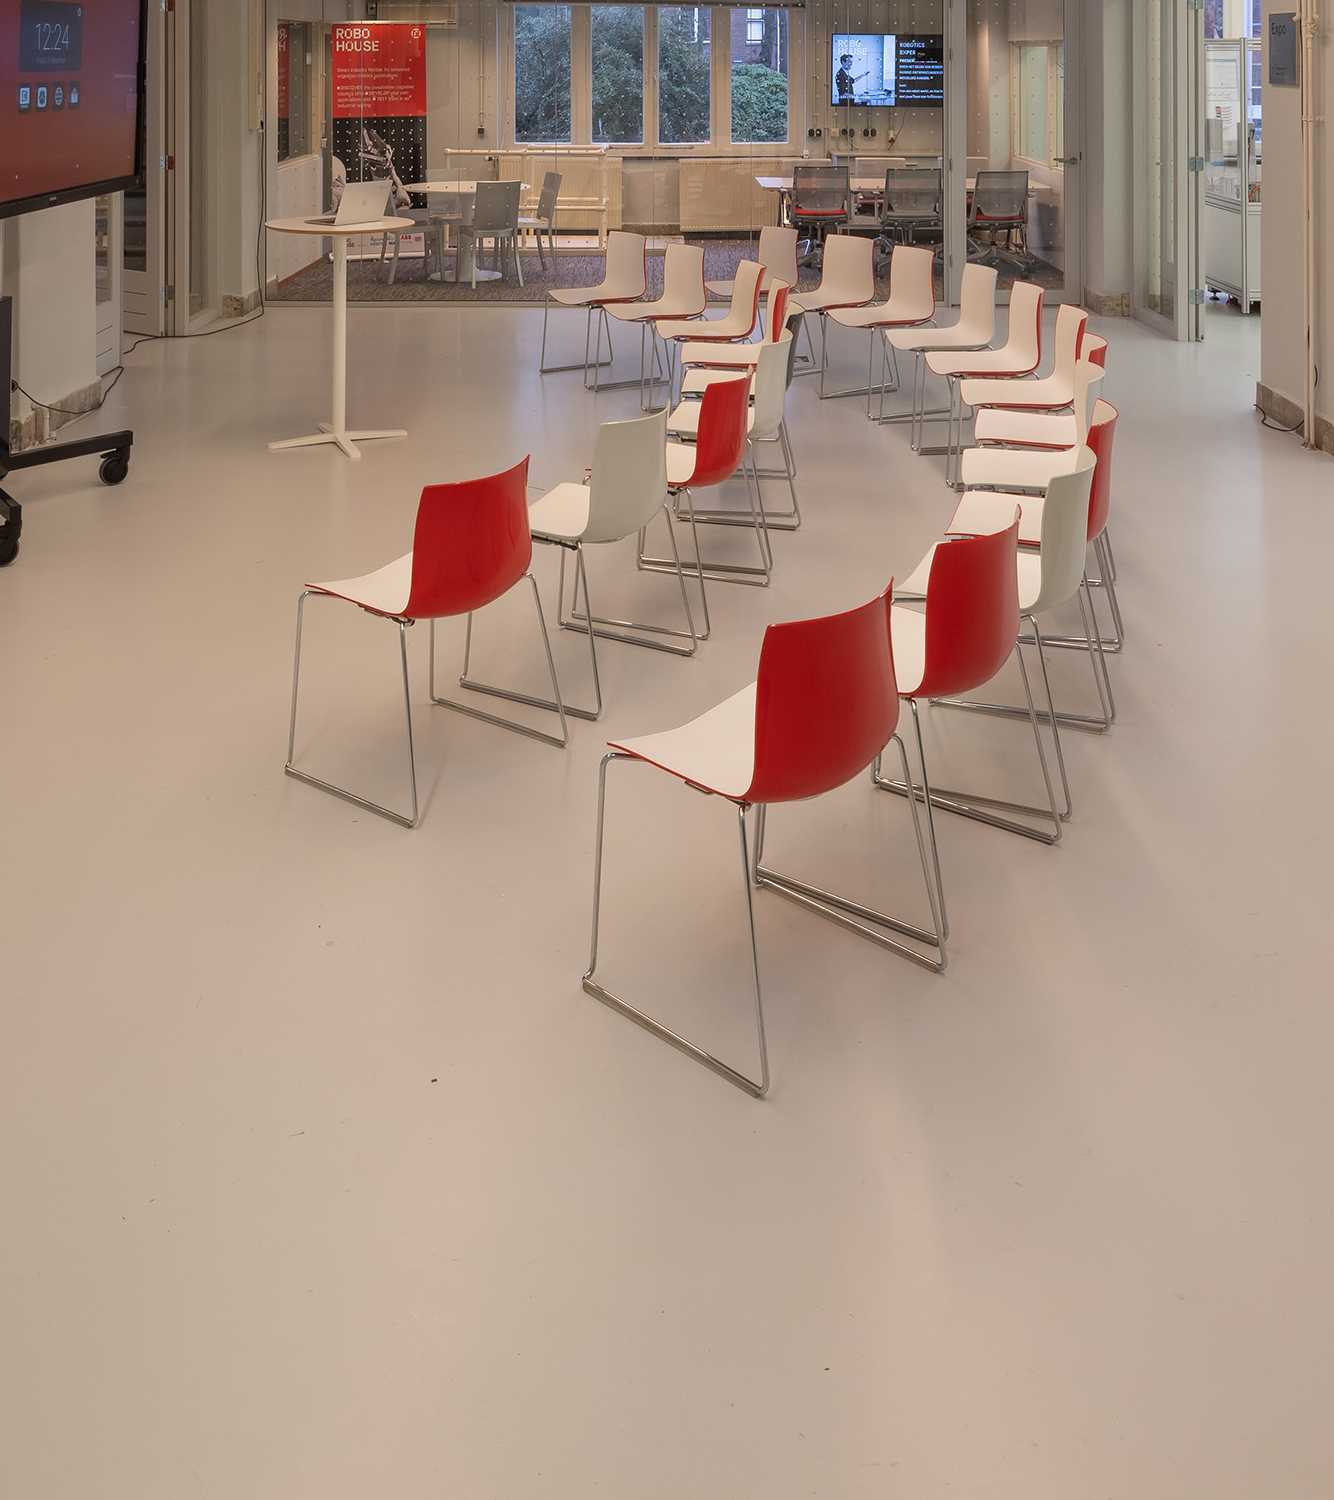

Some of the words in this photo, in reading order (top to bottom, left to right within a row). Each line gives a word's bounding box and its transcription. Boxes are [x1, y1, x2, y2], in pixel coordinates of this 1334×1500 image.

[336, 28, 370, 39] ROBO
[1271, 23, 1286, 36] Expo
[35, 23, 69, 51] 12:24
[336, 40, 379, 52] HOUSE
[837, 39, 862, 48] ROBO
[837, 47, 868, 56] HOUSE
